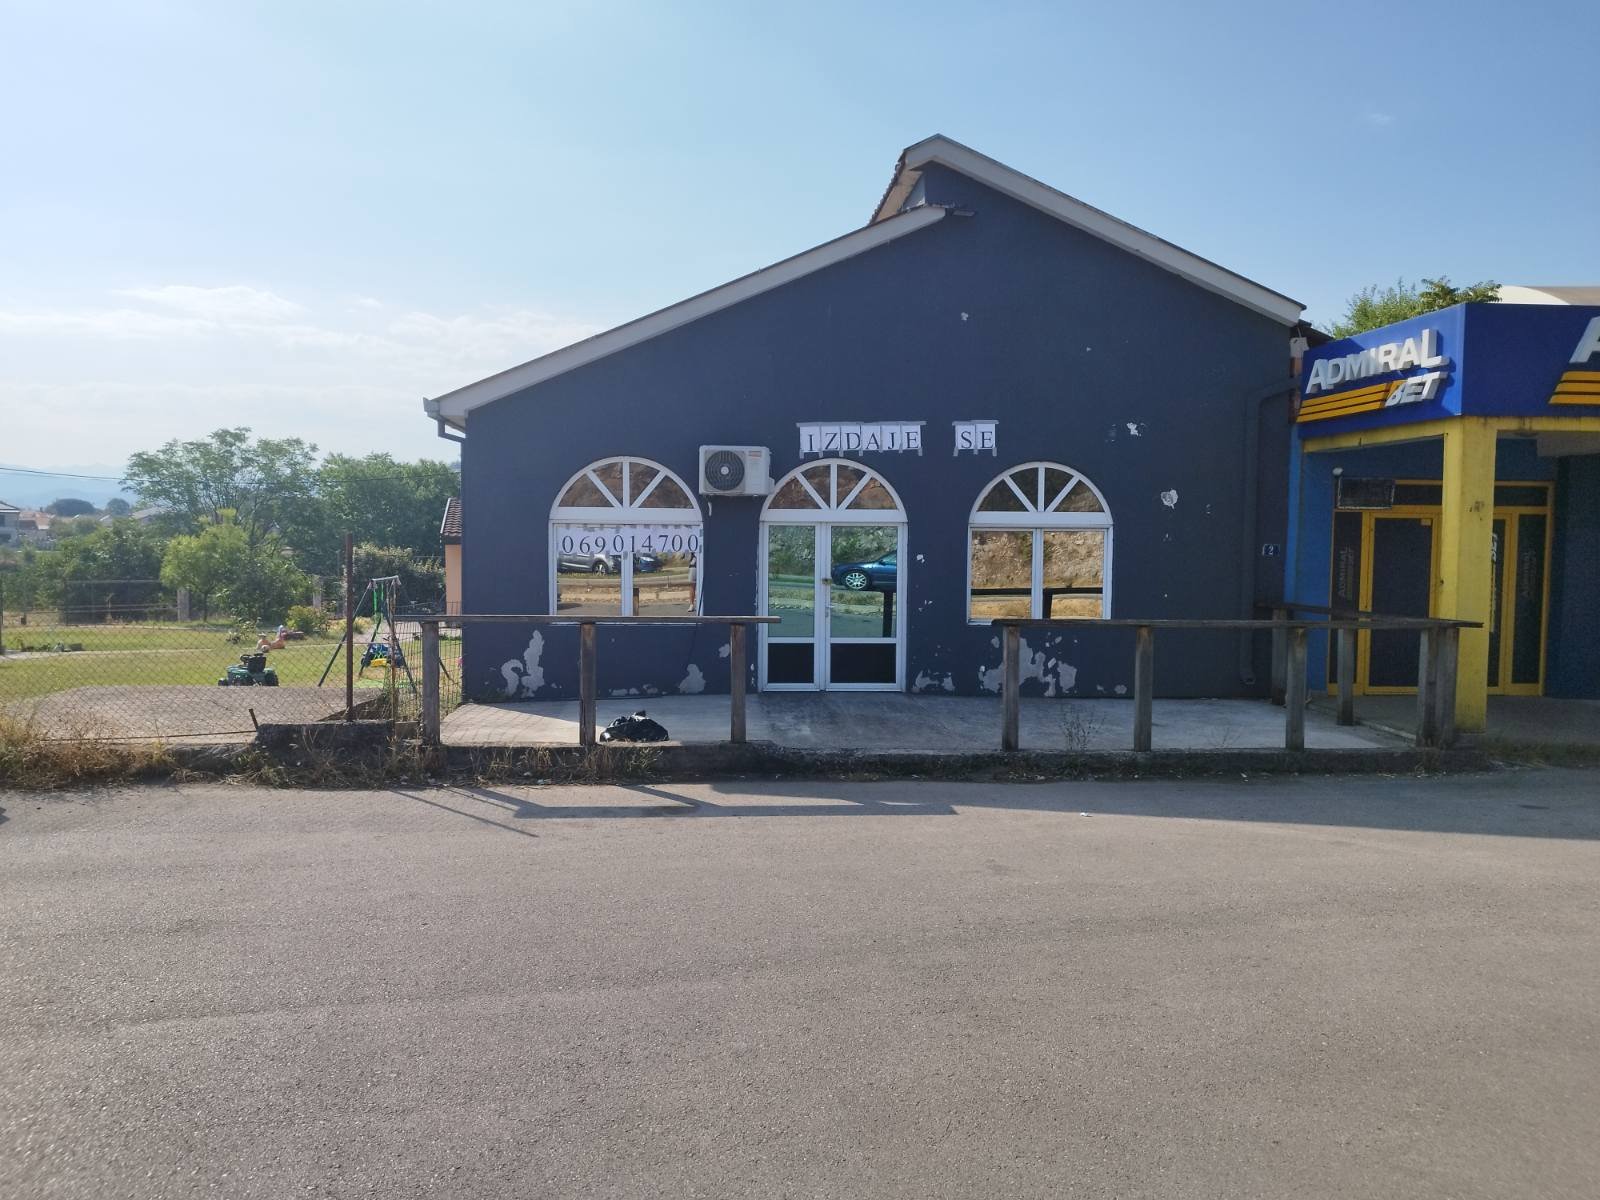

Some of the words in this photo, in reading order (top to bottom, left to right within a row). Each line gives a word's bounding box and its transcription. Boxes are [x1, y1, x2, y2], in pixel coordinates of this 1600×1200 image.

[1305, 328, 1447, 394] ADMIRAL
[1385, 371, 1446, 407] BET
[807, 430, 920, 452] IZDAJE
[960, 430, 994, 450] SE
